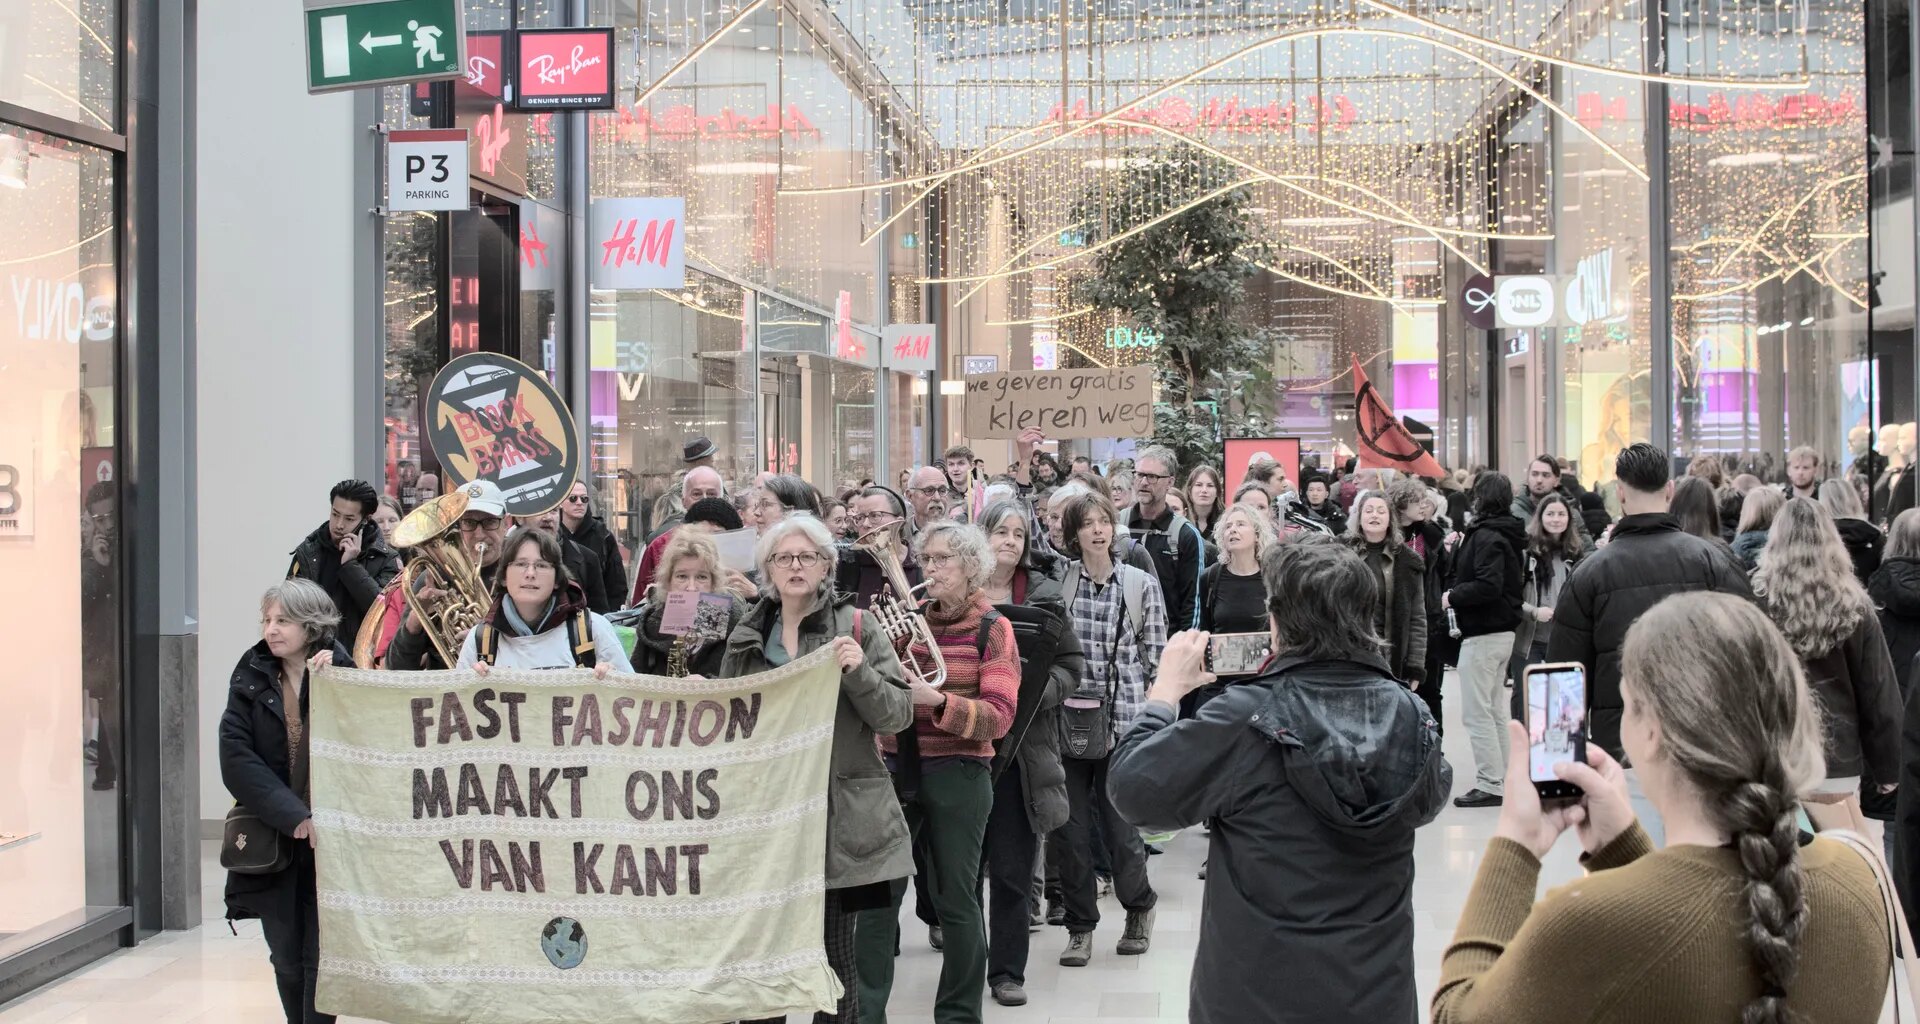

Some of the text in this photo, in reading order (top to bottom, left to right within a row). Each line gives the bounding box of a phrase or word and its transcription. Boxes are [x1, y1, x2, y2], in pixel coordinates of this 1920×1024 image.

[406, 189, 449, 200] PARKING
[601, 217, 676, 269] H&M
[893, 335, 930, 360] H&M
[968, 370, 1135, 402] we geven gratis
[454, 393, 535, 443] BLOCK
[989, 398, 1152, 436] kleren weg
[470, 427, 551, 475] BRASS
[410, 687, 762, 749] FAST FASHION
[412, 763, 721, 821] MAAKT ONS
[439, 838, 710, 897] VAN KANT
